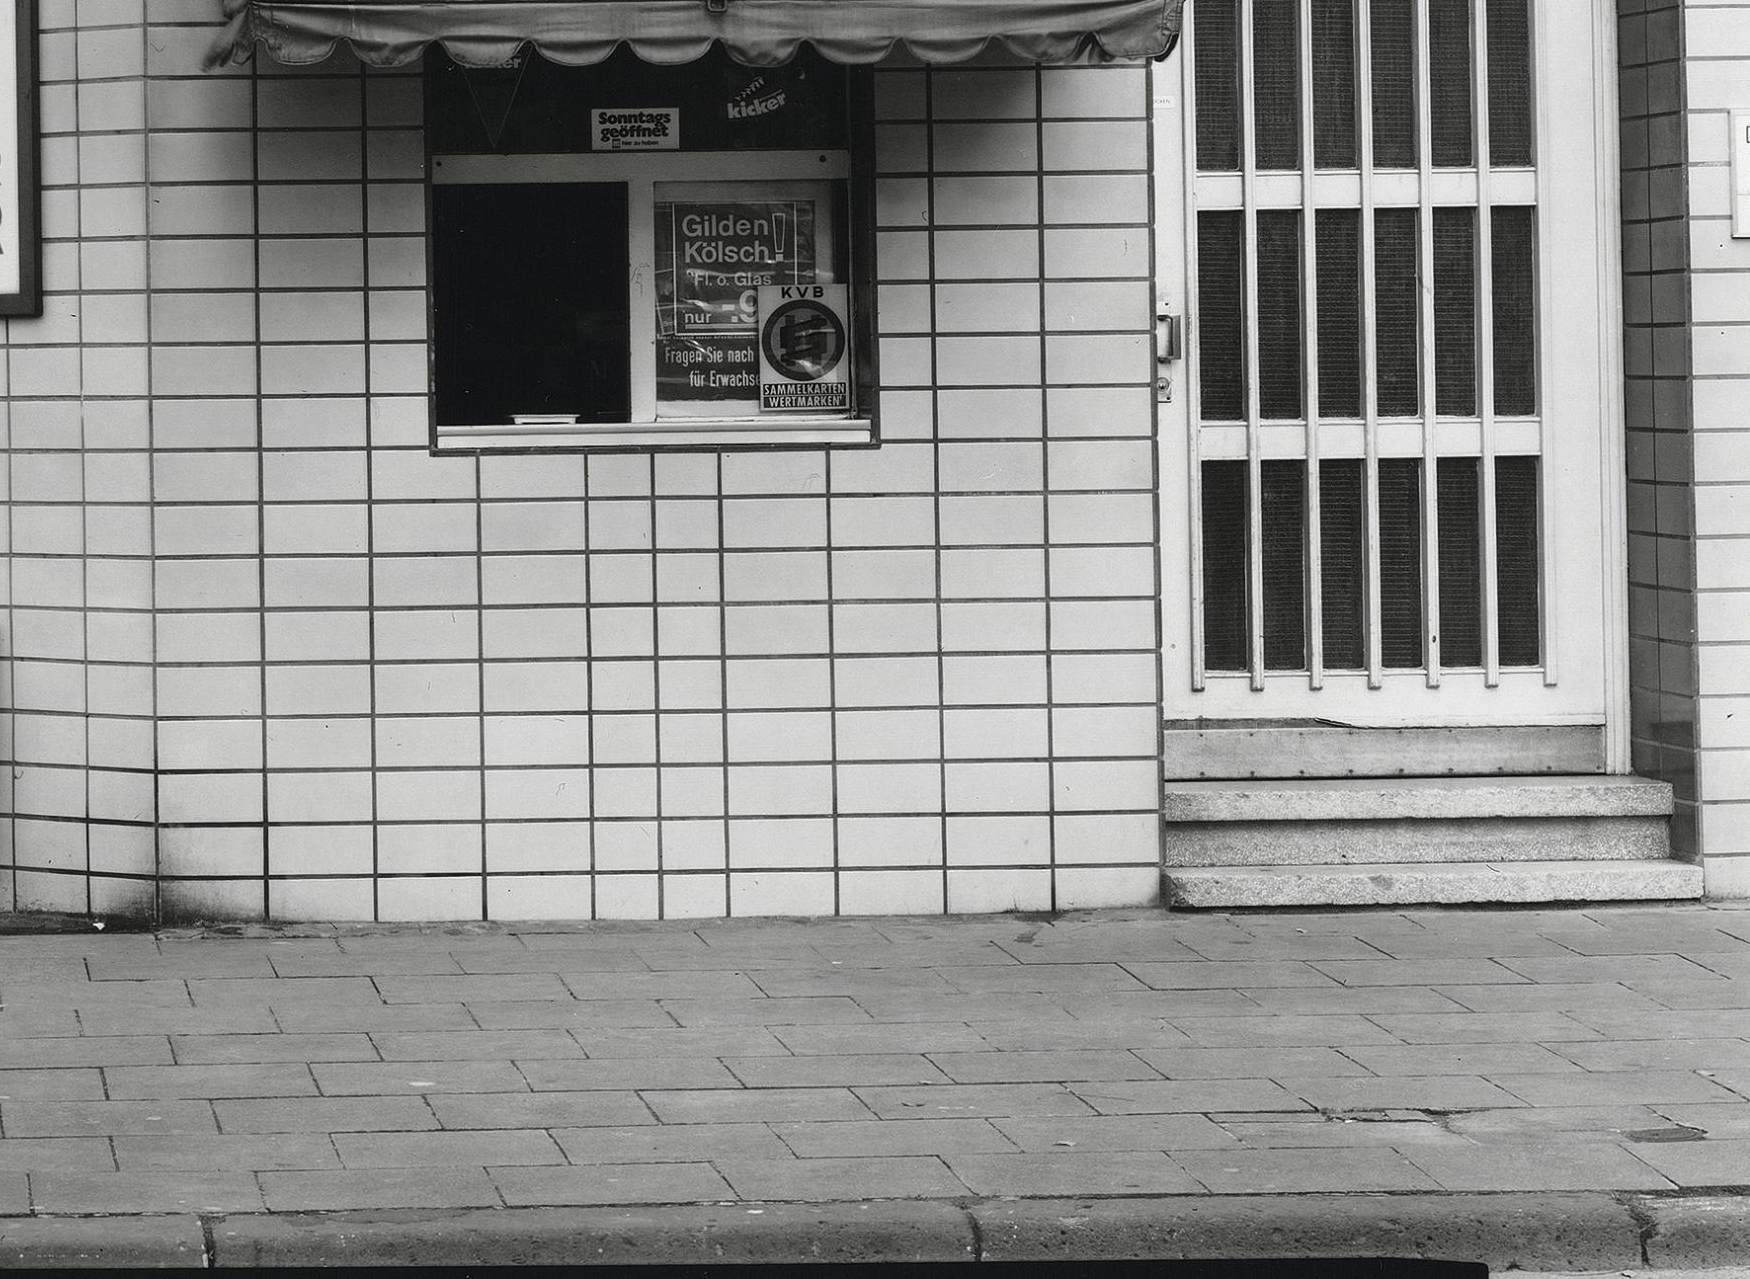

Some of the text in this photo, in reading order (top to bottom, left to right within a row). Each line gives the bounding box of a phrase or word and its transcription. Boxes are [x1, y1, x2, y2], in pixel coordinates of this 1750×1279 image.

[726, 93, 786, 119] kicker
[599, 111, 671, 129] Sonntags
[601, 125, 668, 142] geöffnet
[682, 214, 769, 237] Gilden
[734, 272, 772, 286] Glas
[781, 286, 824, 299] KVB
[684, 313, 712, 324] nur
[665, 346, 754, 367] Fragen Sie nach
[689, 370, 705, 387] für
[764, 383, 845, 395] SAMMELKARTEN
[769, 395, 842, 408] WERTMARKEN
